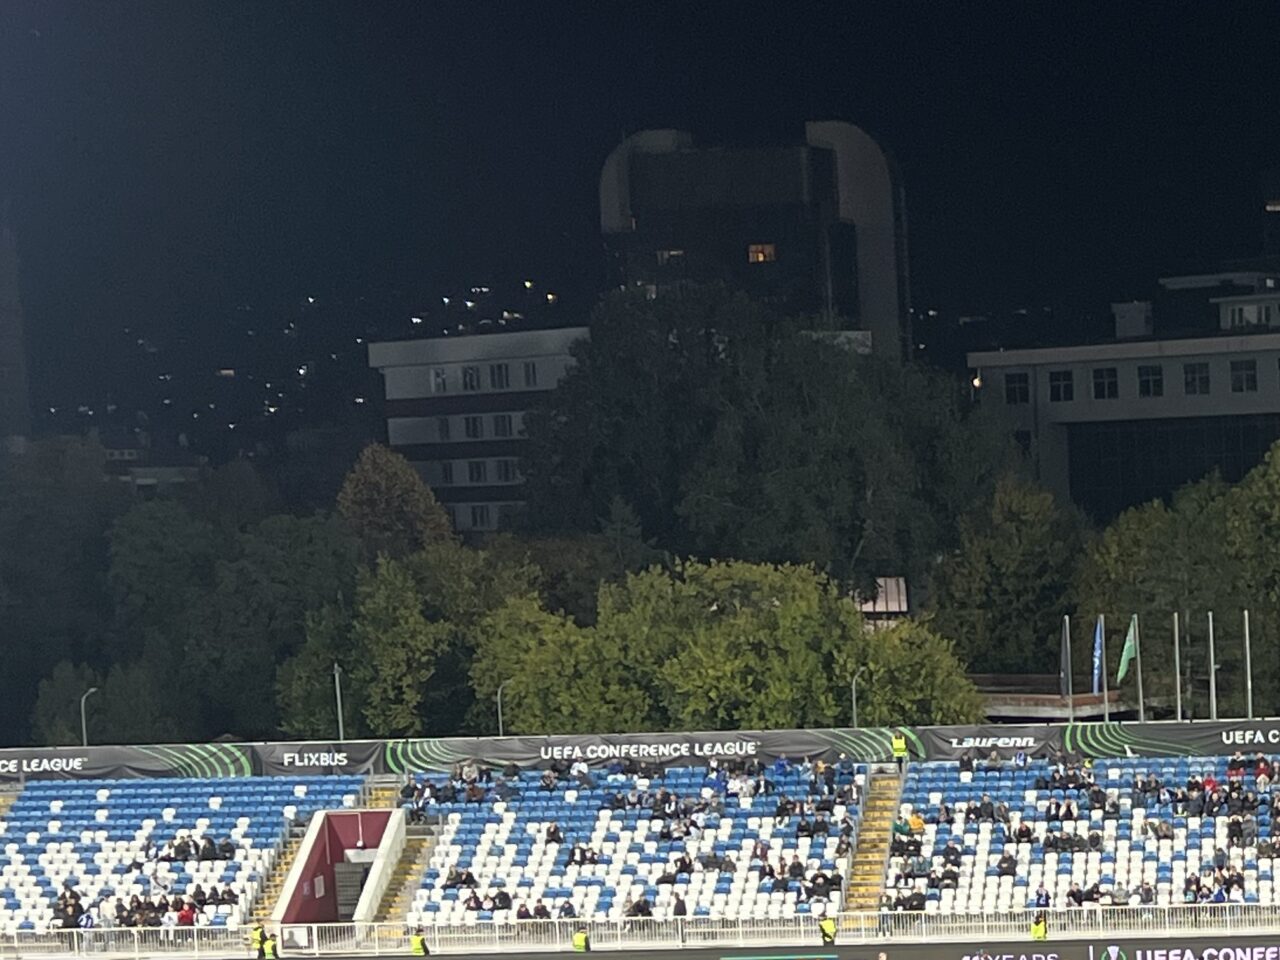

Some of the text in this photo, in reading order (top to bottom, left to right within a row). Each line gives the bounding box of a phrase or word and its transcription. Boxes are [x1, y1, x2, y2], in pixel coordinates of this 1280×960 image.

[1222, 731, 1265, 744] UEFA
[541, 746, 583, 760] UEFA
[586, 743, 690, 759] CONFERENCE
